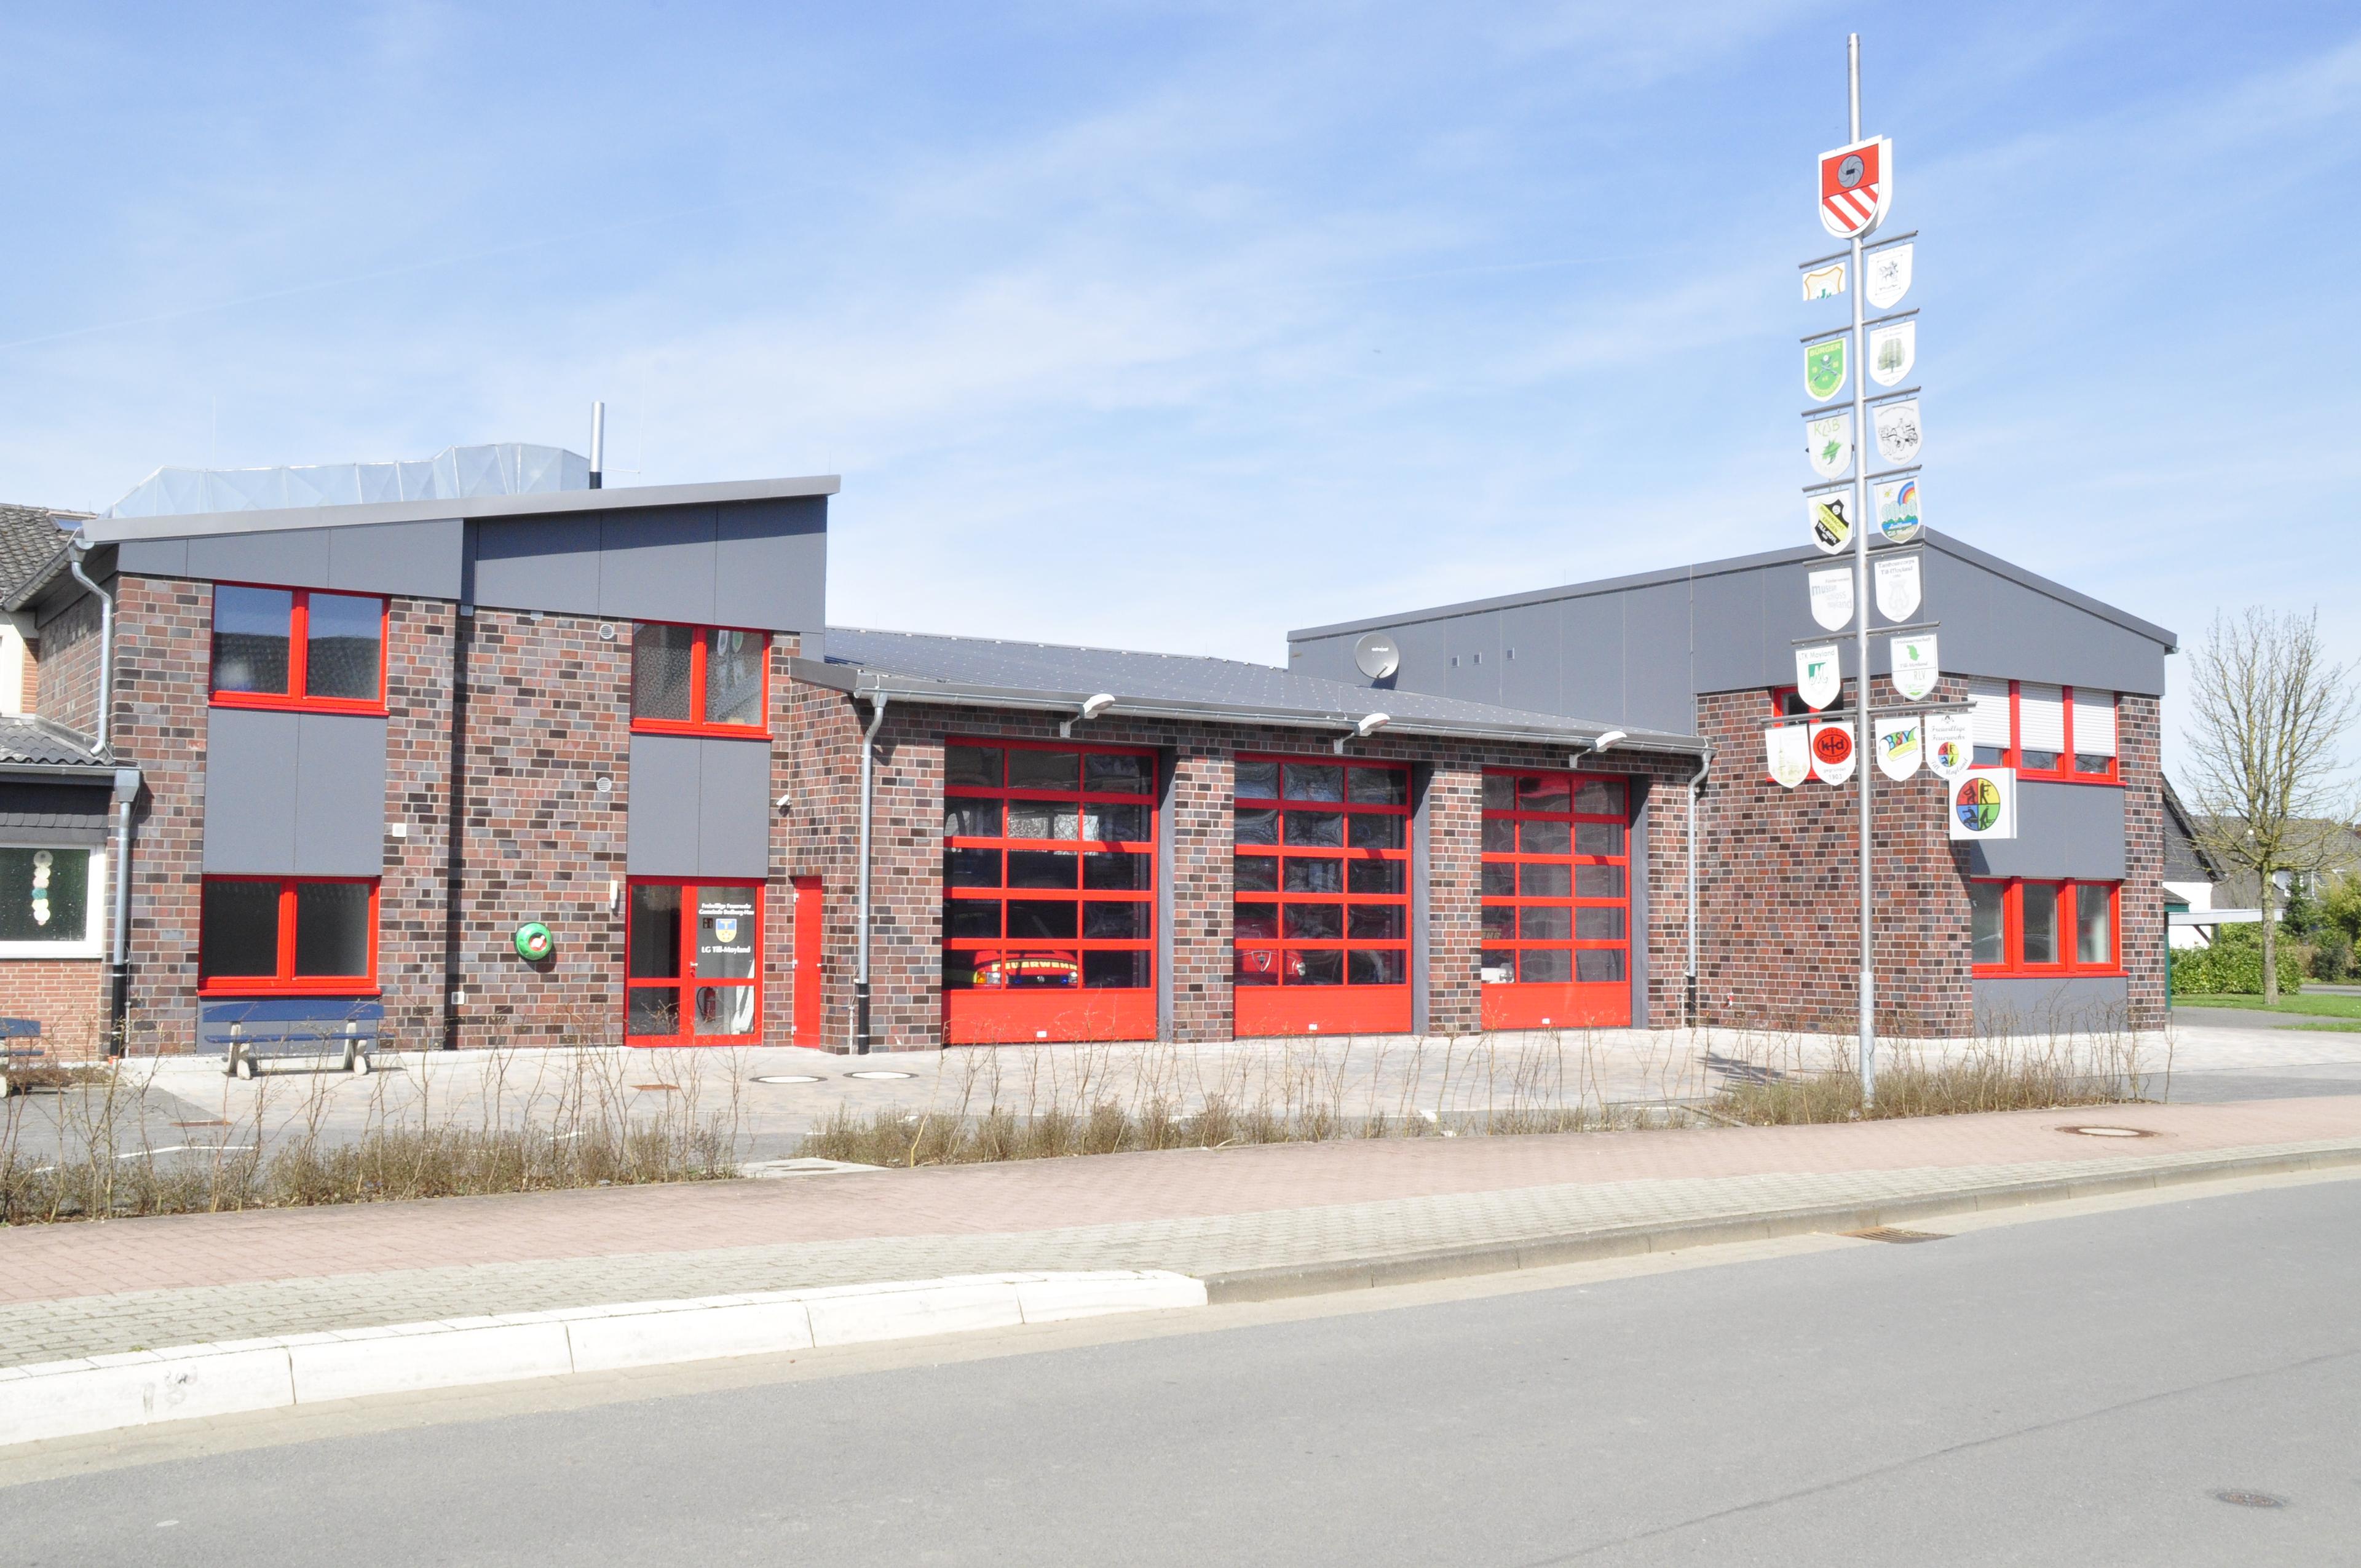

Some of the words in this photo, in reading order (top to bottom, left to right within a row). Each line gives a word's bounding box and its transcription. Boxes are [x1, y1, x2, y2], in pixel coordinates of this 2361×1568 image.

[1809, 343, 1841, 357] BÜRGER
[1809, 649, 1835, 659] Moyland
[1913, 670, 1926, 681] RLV
[712, 946, 751, 954] Till-Moyland
